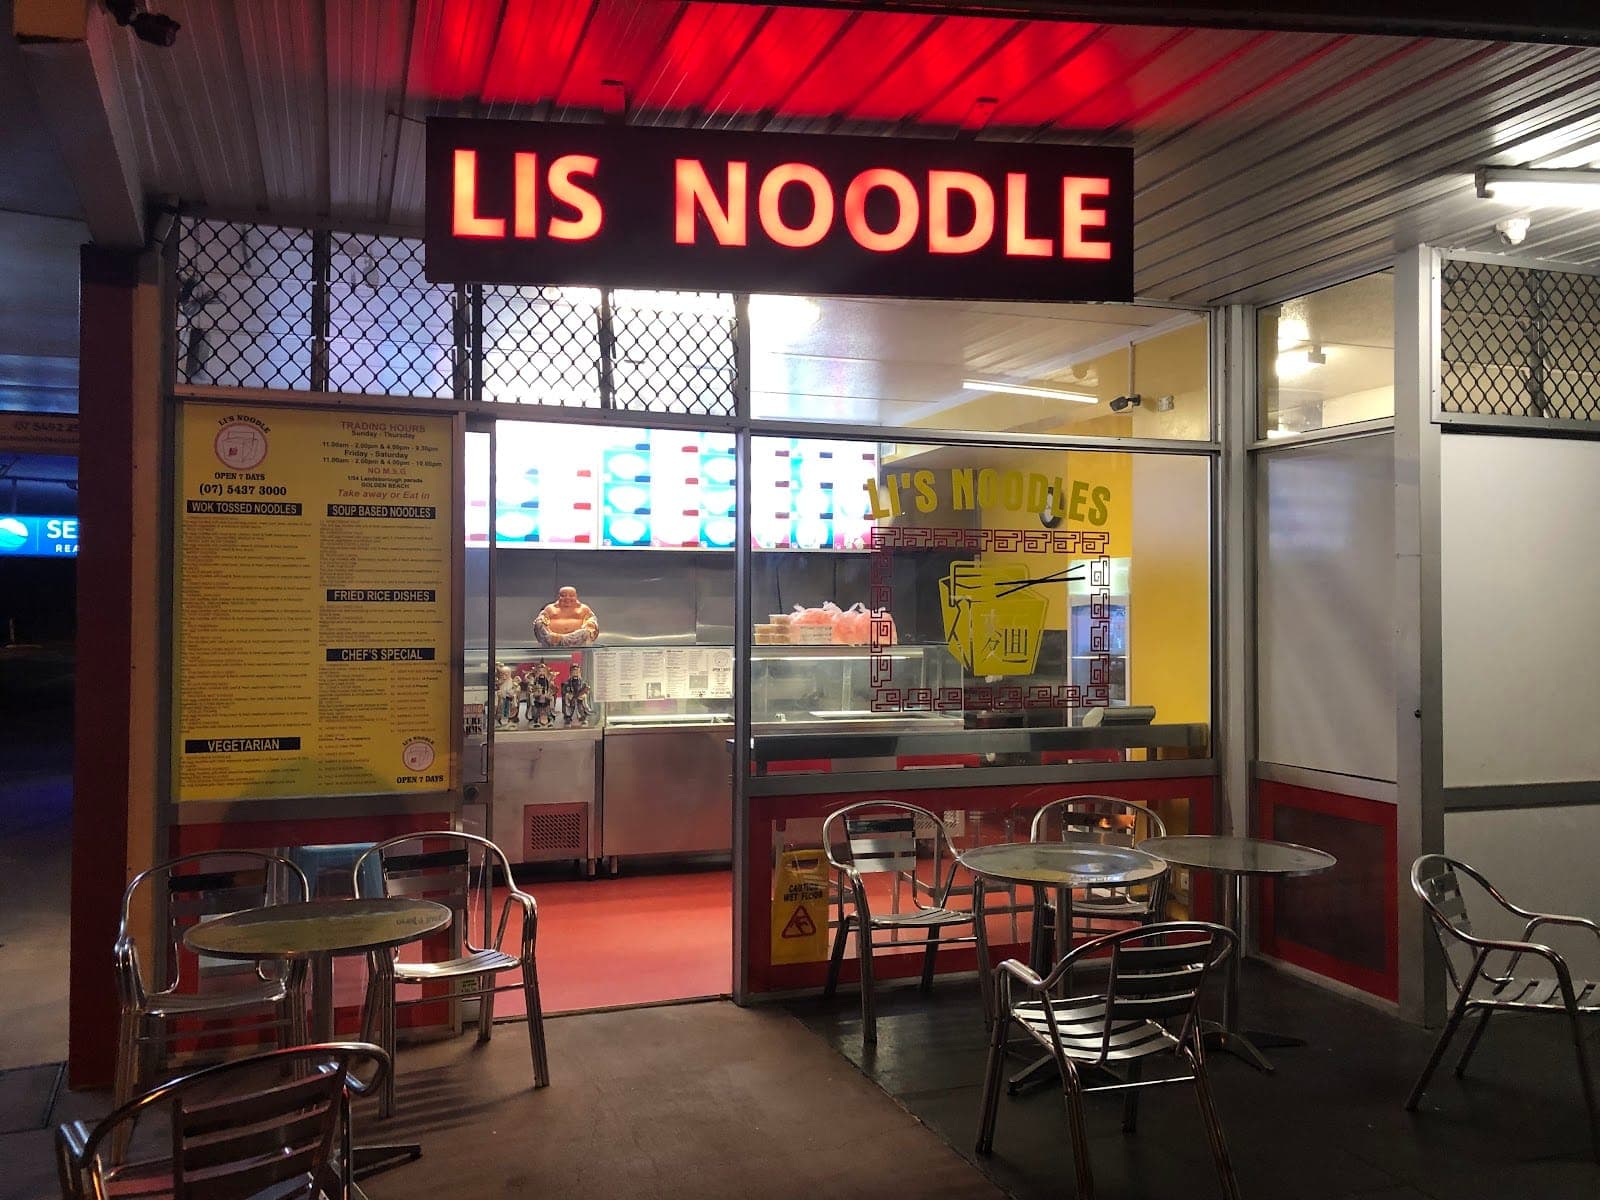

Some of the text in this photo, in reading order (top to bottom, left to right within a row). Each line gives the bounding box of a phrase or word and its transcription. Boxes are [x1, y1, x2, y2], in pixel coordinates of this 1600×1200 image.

[451, 147, 1113, 261] LIS NOODLE
[237, 414, 271, 434] NOODLE
[341, 421, 426, 433] TRADING HOURS
[352, 430, 376, 438] Sunday
[384, 431, 415, 439] Thursday
[344, 449, 368, 457] Friday
[375, 450, 408, 459] Saturday
[214, 472, 237, 480] OPEN
[199, 483, 287, 496] (07) 5437 3000
[337, 489, 359, 497] Take
[362, 490, 388, 499] away
[421, 492, 431, 500] in
[951, 467, 1112, 527] NOODLES
[191, 501, 297, 515] WOK TOSSED NOODLES
[332, 504, 431, 518] SOUP BASED NOODLES
[333, 590, 430, 602] FRIED RICE DISHES
[341, 648, 424, 661] CHEF'S SPECIAL
[207, 738, 280, 752] VEGETARIAN
[396, 776, 417, 784] OPEN
[425, 775, 445, 783] DAYS
[784, 890, 823, 902] WET FLOOR
